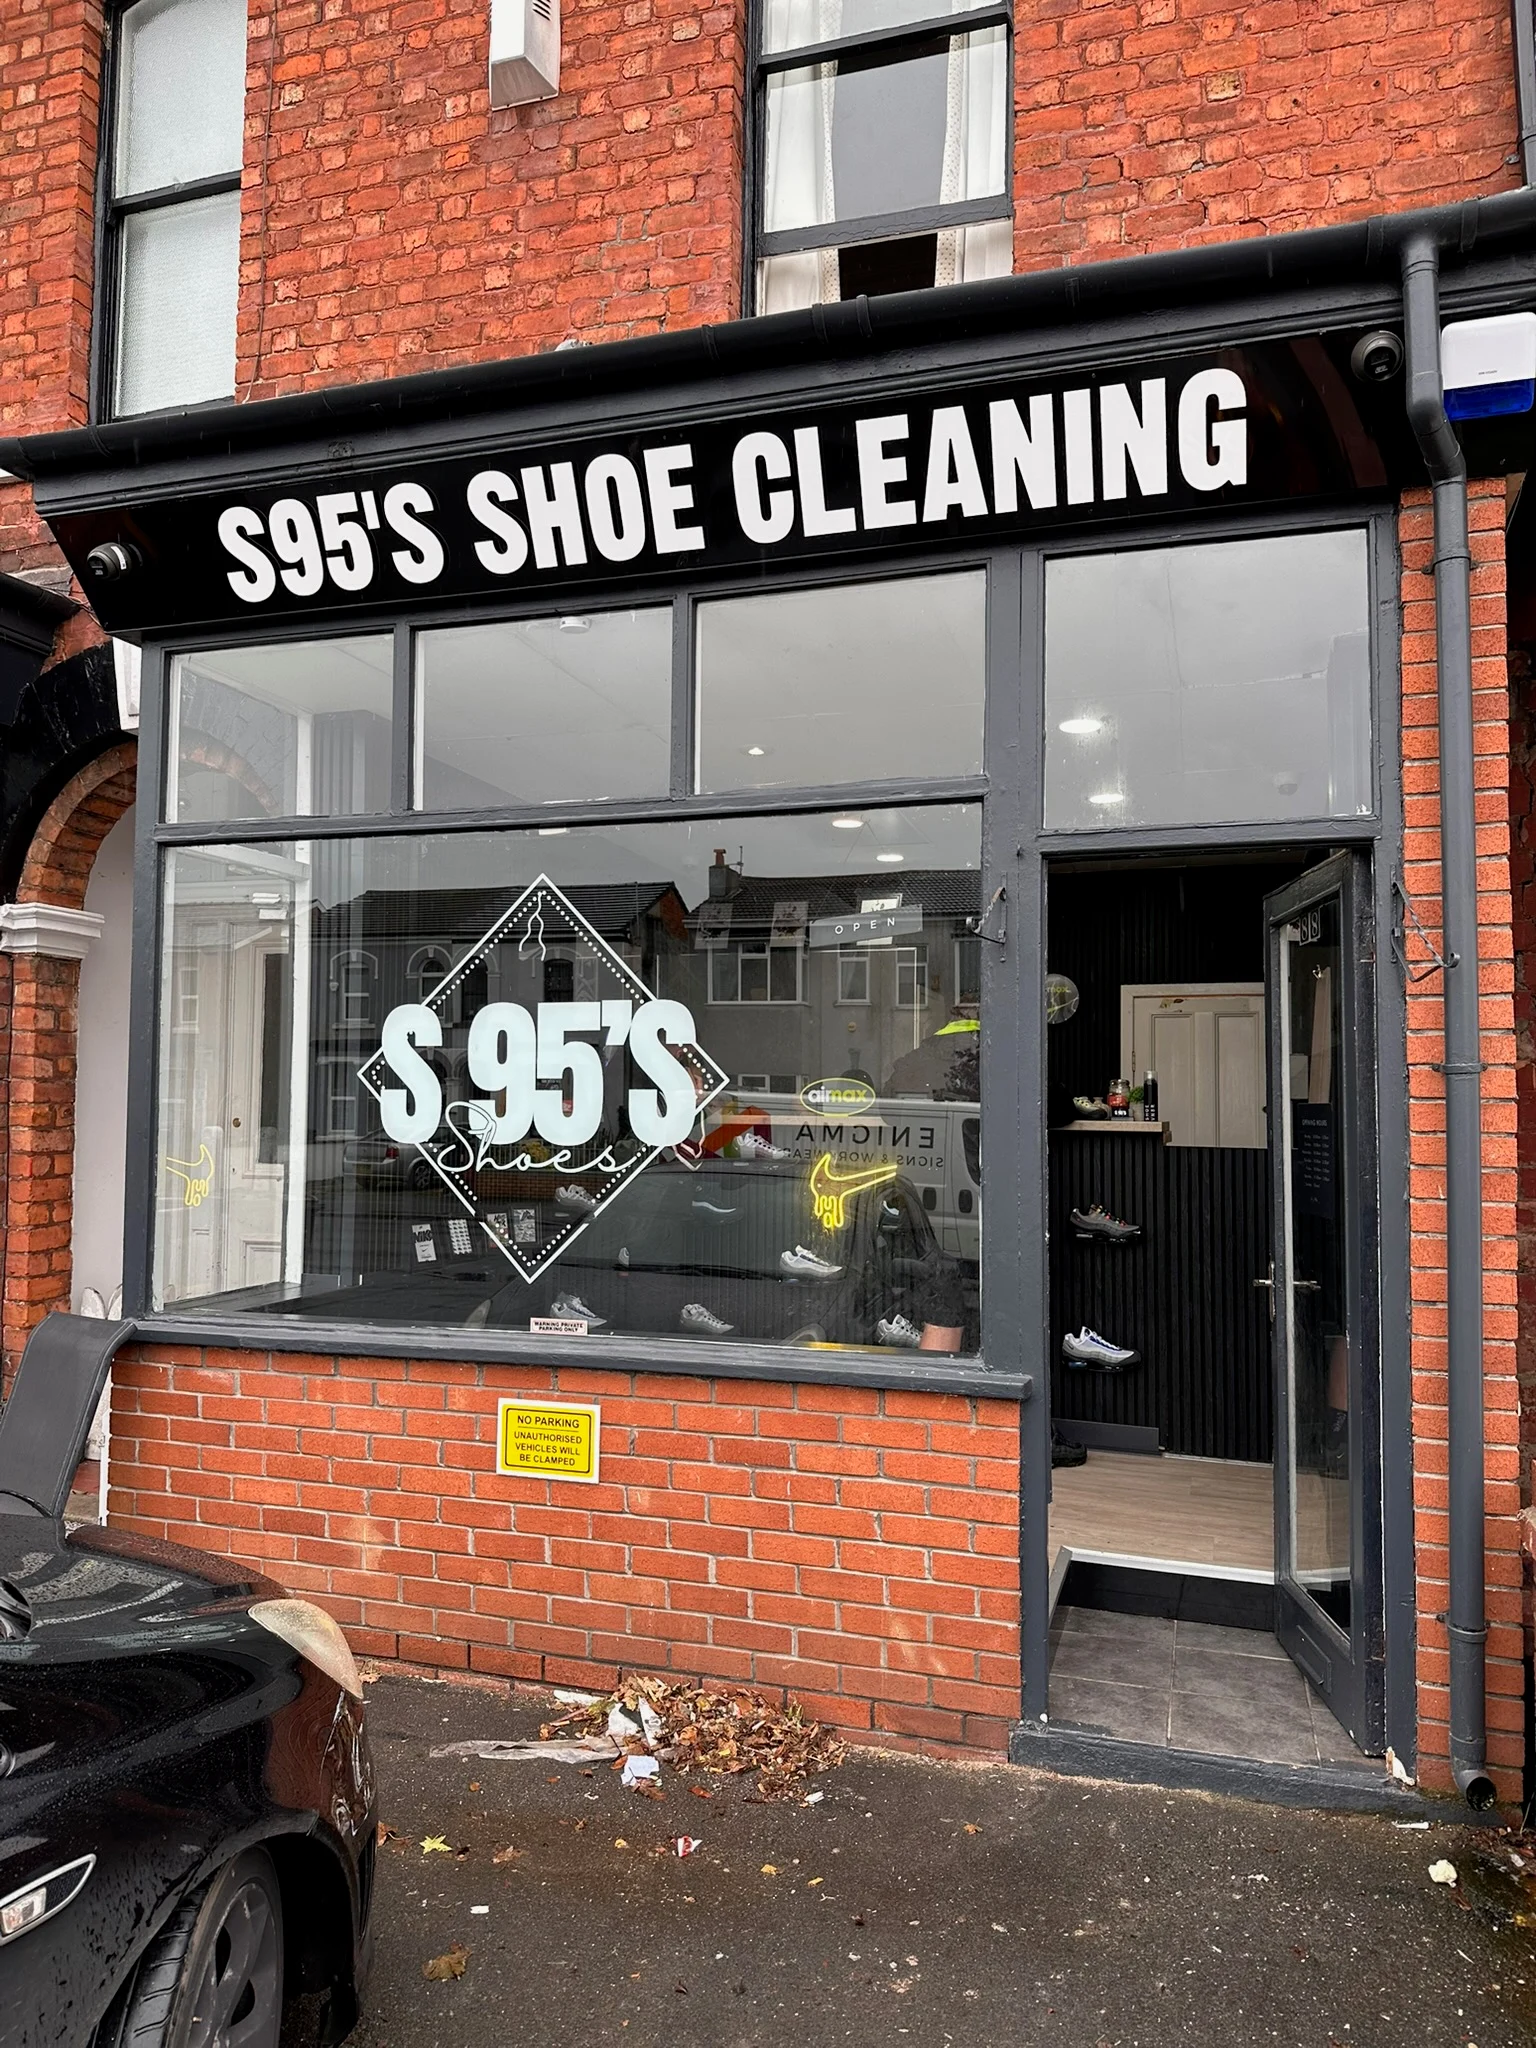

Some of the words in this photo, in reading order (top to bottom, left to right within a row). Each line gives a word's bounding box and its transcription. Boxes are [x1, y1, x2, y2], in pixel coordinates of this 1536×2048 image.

[217, 482, 445, 602] S95'S
[467, 443, 706, 575] SHOE
[732, 368, 1248, 544] CLEANING
[834, 917, 896, 935] OPEN
[807, 1085, 868, 1103] airmax
[437, 1100, 635, 1174] Shoes
[517, 1415, 532, 1424] NO
[534, 1416, 580, 1428] PARKING
[514, 1431, 582, 1444] UNAUTHORISED
[515, 1442, 557, 1453] VEHICLES
[560, 1446, 580, 1455] WILL
[519, 1453, 531, 1462] BE
[533, 1455, 575, 1466] CLAMPED
